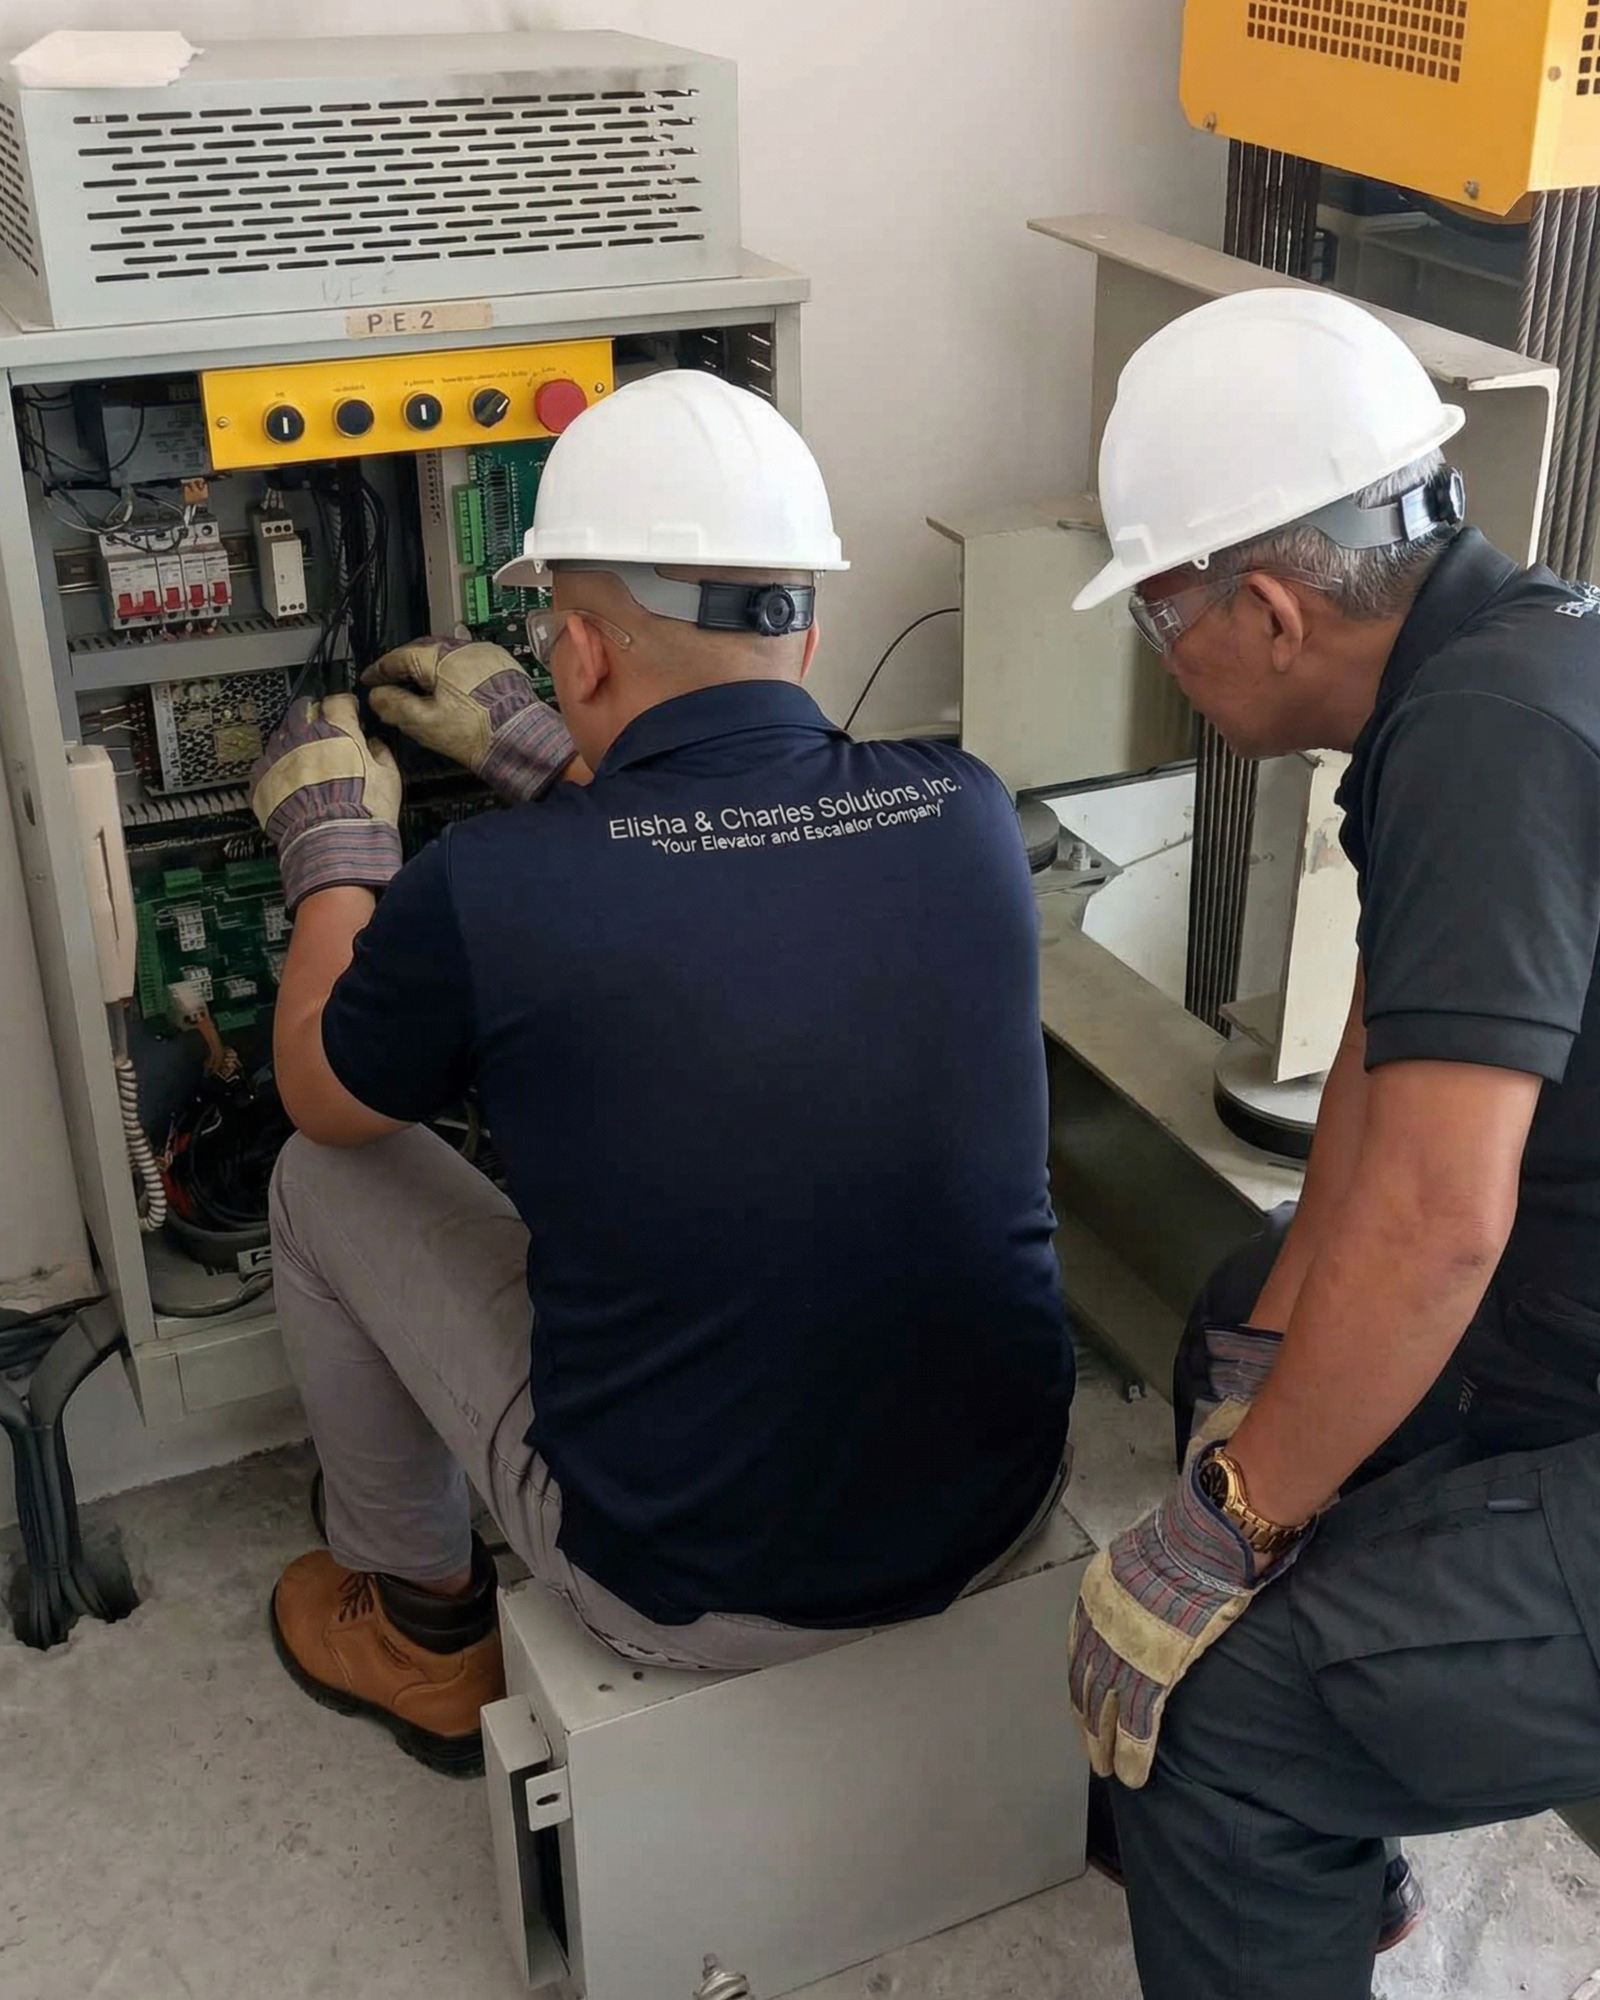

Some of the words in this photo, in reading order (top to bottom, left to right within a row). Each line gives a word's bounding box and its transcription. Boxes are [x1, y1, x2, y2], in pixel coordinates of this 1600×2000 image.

[609, 814, 687, 839] Elisha
[694, 810, 712, 832] &
[720, 803, 814, 829] Charles
[818, 785, 926, 817] Solutions,
[922, 776, 962, 796] Inc.
[701, 833, 766, 850] Elevator
[771, 828, 800, 845] and
